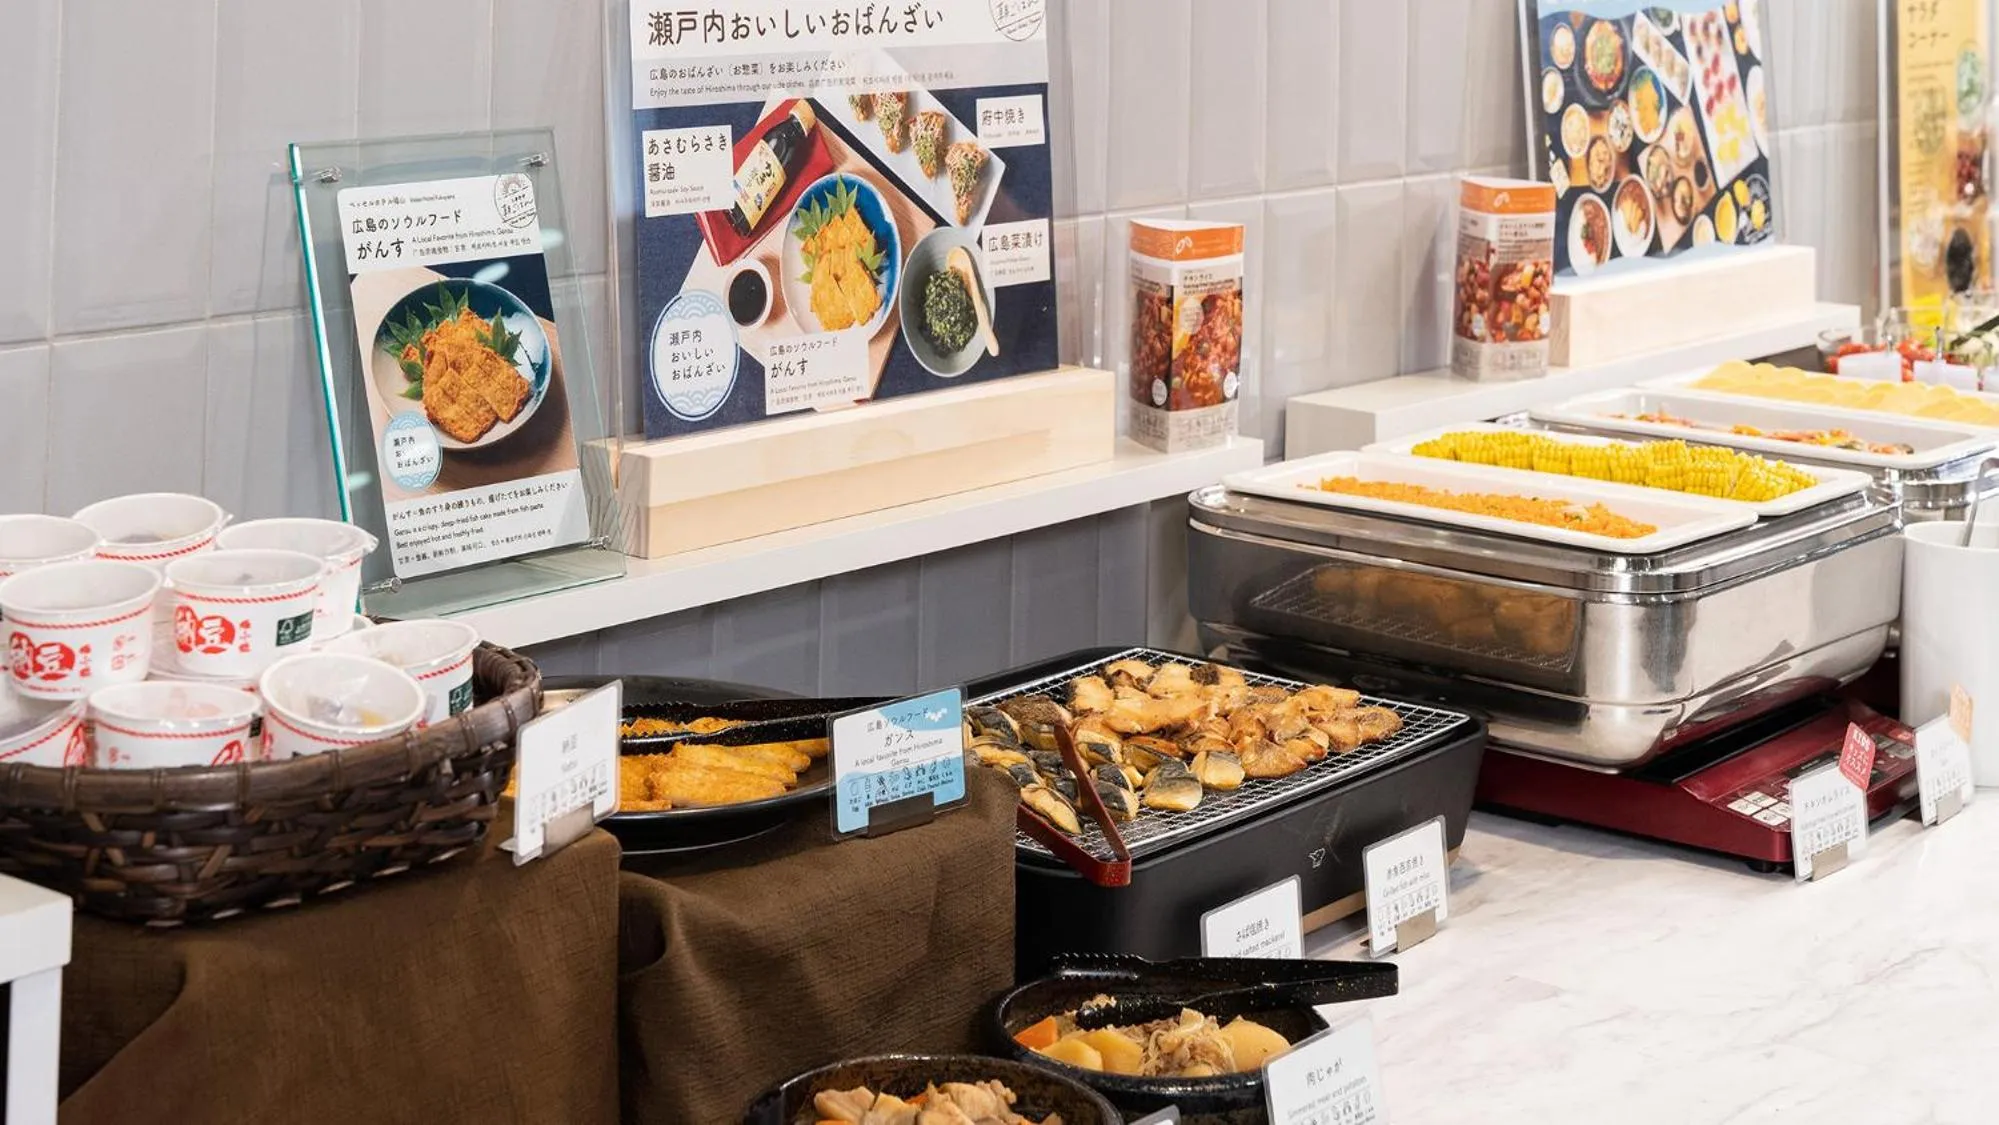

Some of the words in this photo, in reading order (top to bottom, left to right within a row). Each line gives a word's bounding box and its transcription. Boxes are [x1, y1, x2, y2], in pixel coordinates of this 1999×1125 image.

[648, 1, 944, 46] 瀬戸内おいしいおばんざい
[650, 87, 667, 97] Enjoy
[669, 87, 680, 95] the
[981, 107, 1025, 126] 府中焼き
[648, 133, 727, 156] あさむらさき
[648, 162, 675, 182] 醤油
[352, 209, 462, 234] 広島のソウルフード
[357, 238, 404, 260] がんす
[989, 232, 1043, 252] 広島菜漬け
[669, 330, 703, 346] 瀬戸内
[769, 337, 839, 357] 広島のソウルフード
[671, 346, 714, 363] おいしい
[672, 363, 726, 381] おばんざい
[770, 357, 809, 379] がんす
[884, 729, 914, 748] ガンス
